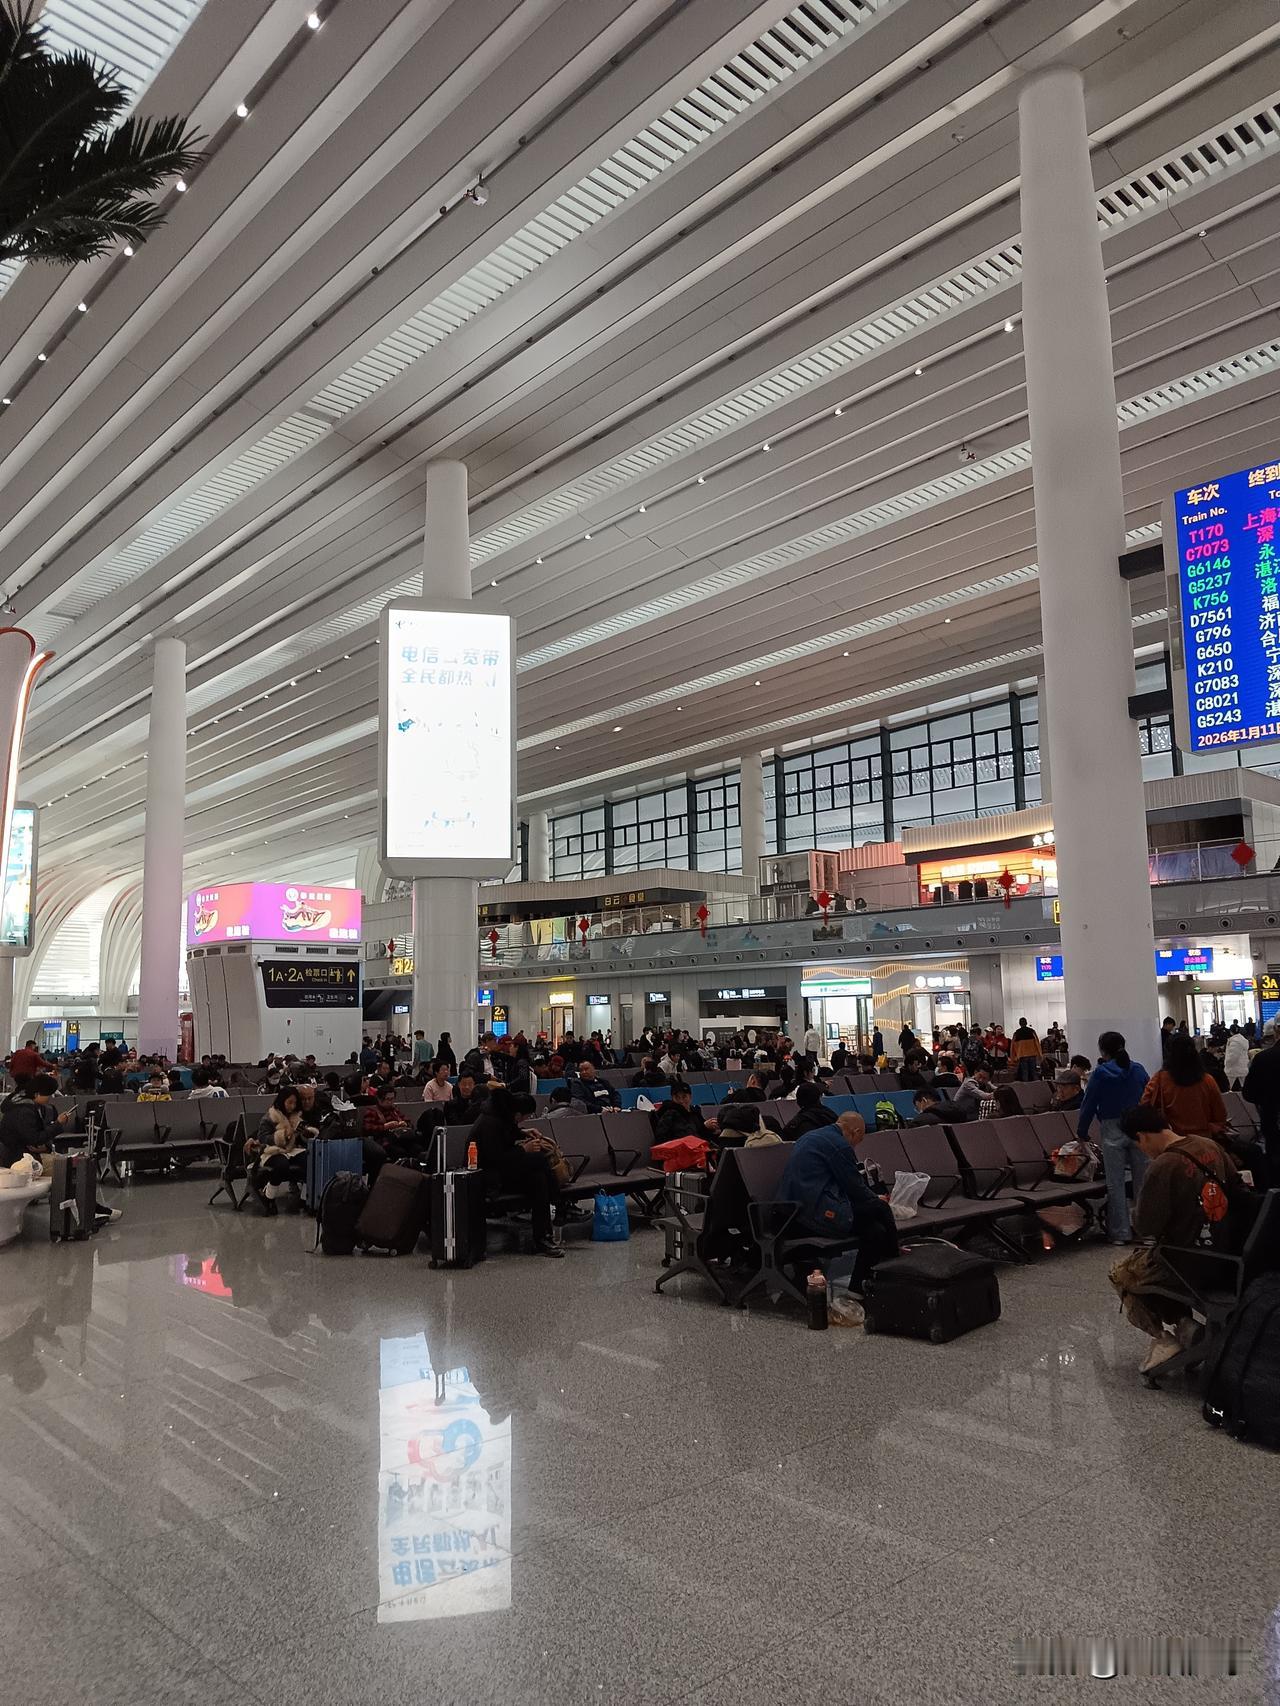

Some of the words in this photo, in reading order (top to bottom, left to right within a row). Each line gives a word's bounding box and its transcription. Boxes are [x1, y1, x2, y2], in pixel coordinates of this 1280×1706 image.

[1187, 483, 1220, 505] 车次
[1182, 511, 1208, 525] Train
[1210, 506, 1228, 518] No.
[1243, 507, 1280, 530] 上海
[1189, 523, 1224, 544] T170
[1186, 538, 1230, 562] C7073
[1259, 543, 1275, 560] 永
[1187, 555, 1231, 578] G6146
[1188, 572, 1231, 594] G5237
[1260, 577, 1278, 595] 洛
[1193, 590, 1229, 611] K756
[1262, 593, 1280, 612] 福
[1190, 606, 1232, 628] D7561
[1259, 611, 1280, 630] 济
[1195, 624, 1231, 643] G796
[1260, 628, 1280, 648] 合
[401, 645, 500, 667] 电信宽带
[1196, 641, 1232, 661] G650
[1197, 658, 1233, 678] K210
[1194, 674, 1239, 695] C7083
[1196, 691, 1239, 712] C8021
[1197, 708, 1242, 729] G5243
[305, 968, 328, 977] 检票口
[1262, 975, 1278, 989] 3A
[494, 1006, 505, 1016] 2A
